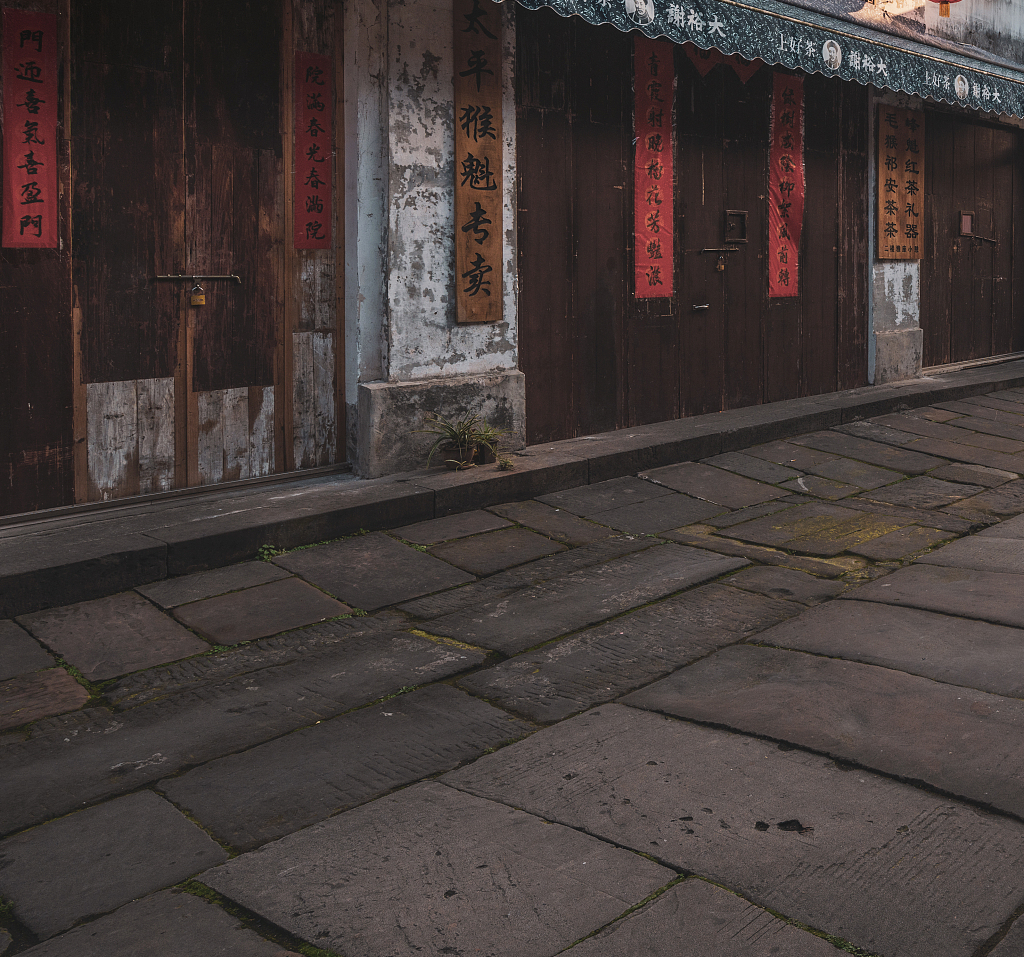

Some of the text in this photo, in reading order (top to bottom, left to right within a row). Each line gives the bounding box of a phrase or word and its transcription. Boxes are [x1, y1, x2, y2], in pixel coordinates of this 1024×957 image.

[666, 3, 727, 39] 謝裕大
[777, 34, 818, 58] 上好茶
[847, 49, 889, 77] 謝裕大
[922, 70, 952, 90] 上好茶
